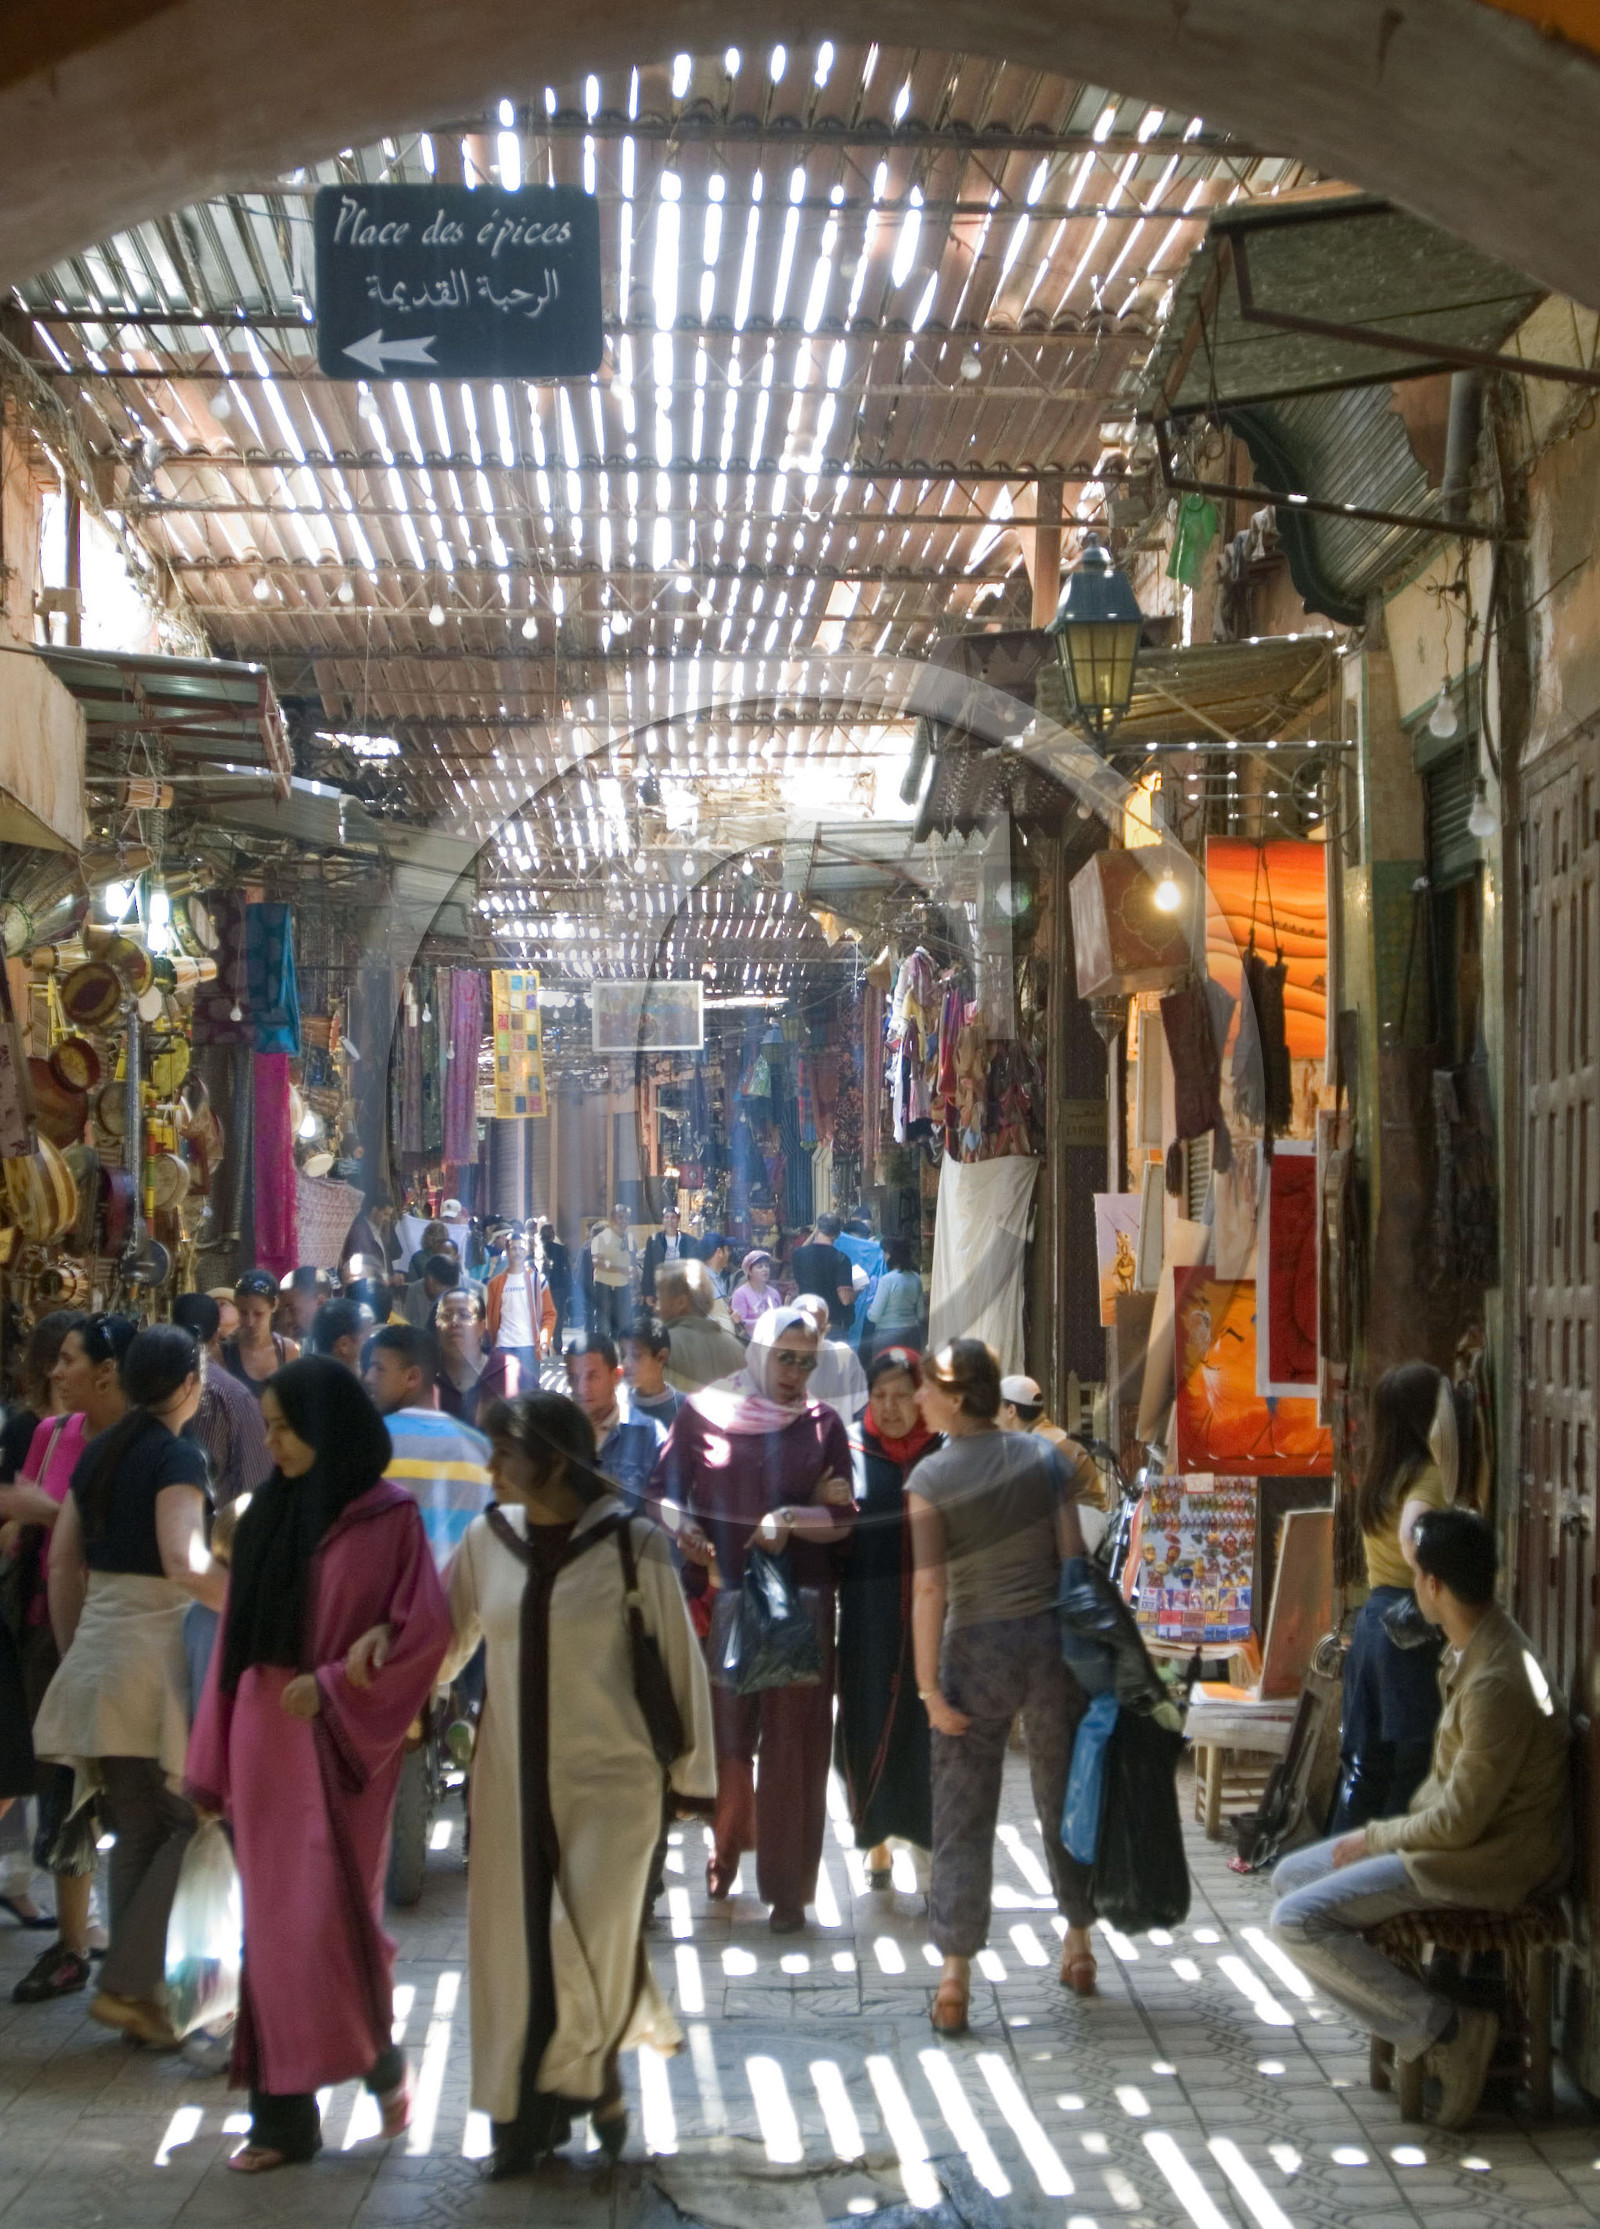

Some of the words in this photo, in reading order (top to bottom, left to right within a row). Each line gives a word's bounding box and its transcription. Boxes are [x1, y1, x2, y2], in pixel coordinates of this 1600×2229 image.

[333, 194, 410, 245] Place
[421, 208, 465, 245] des
[476, 208, 572, 258] épices
[365, 268, 471, 312] القديمة
[476, 268, 560, 318] الرحبة
